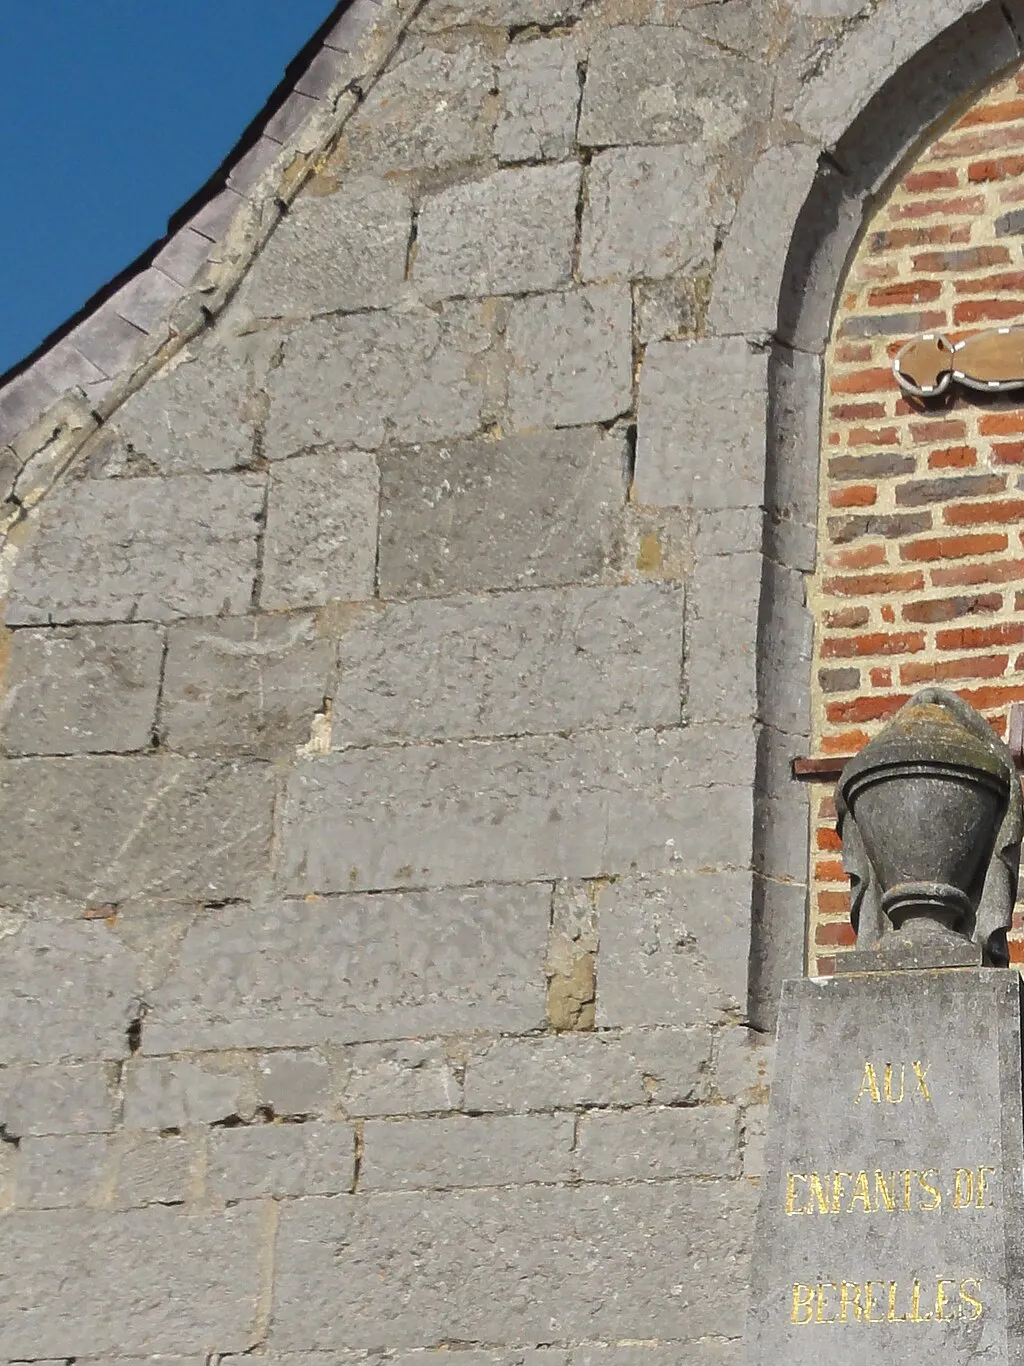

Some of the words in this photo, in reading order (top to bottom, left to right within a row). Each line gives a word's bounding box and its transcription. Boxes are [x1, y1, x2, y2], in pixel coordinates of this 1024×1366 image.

[854, 1060, 932, 1105] AUX
[785, 1168, 942, 1216] ENFANTS
[953, 1165, 996, 1210] DE
[790, 1276, 984, 1326] BERELLES
